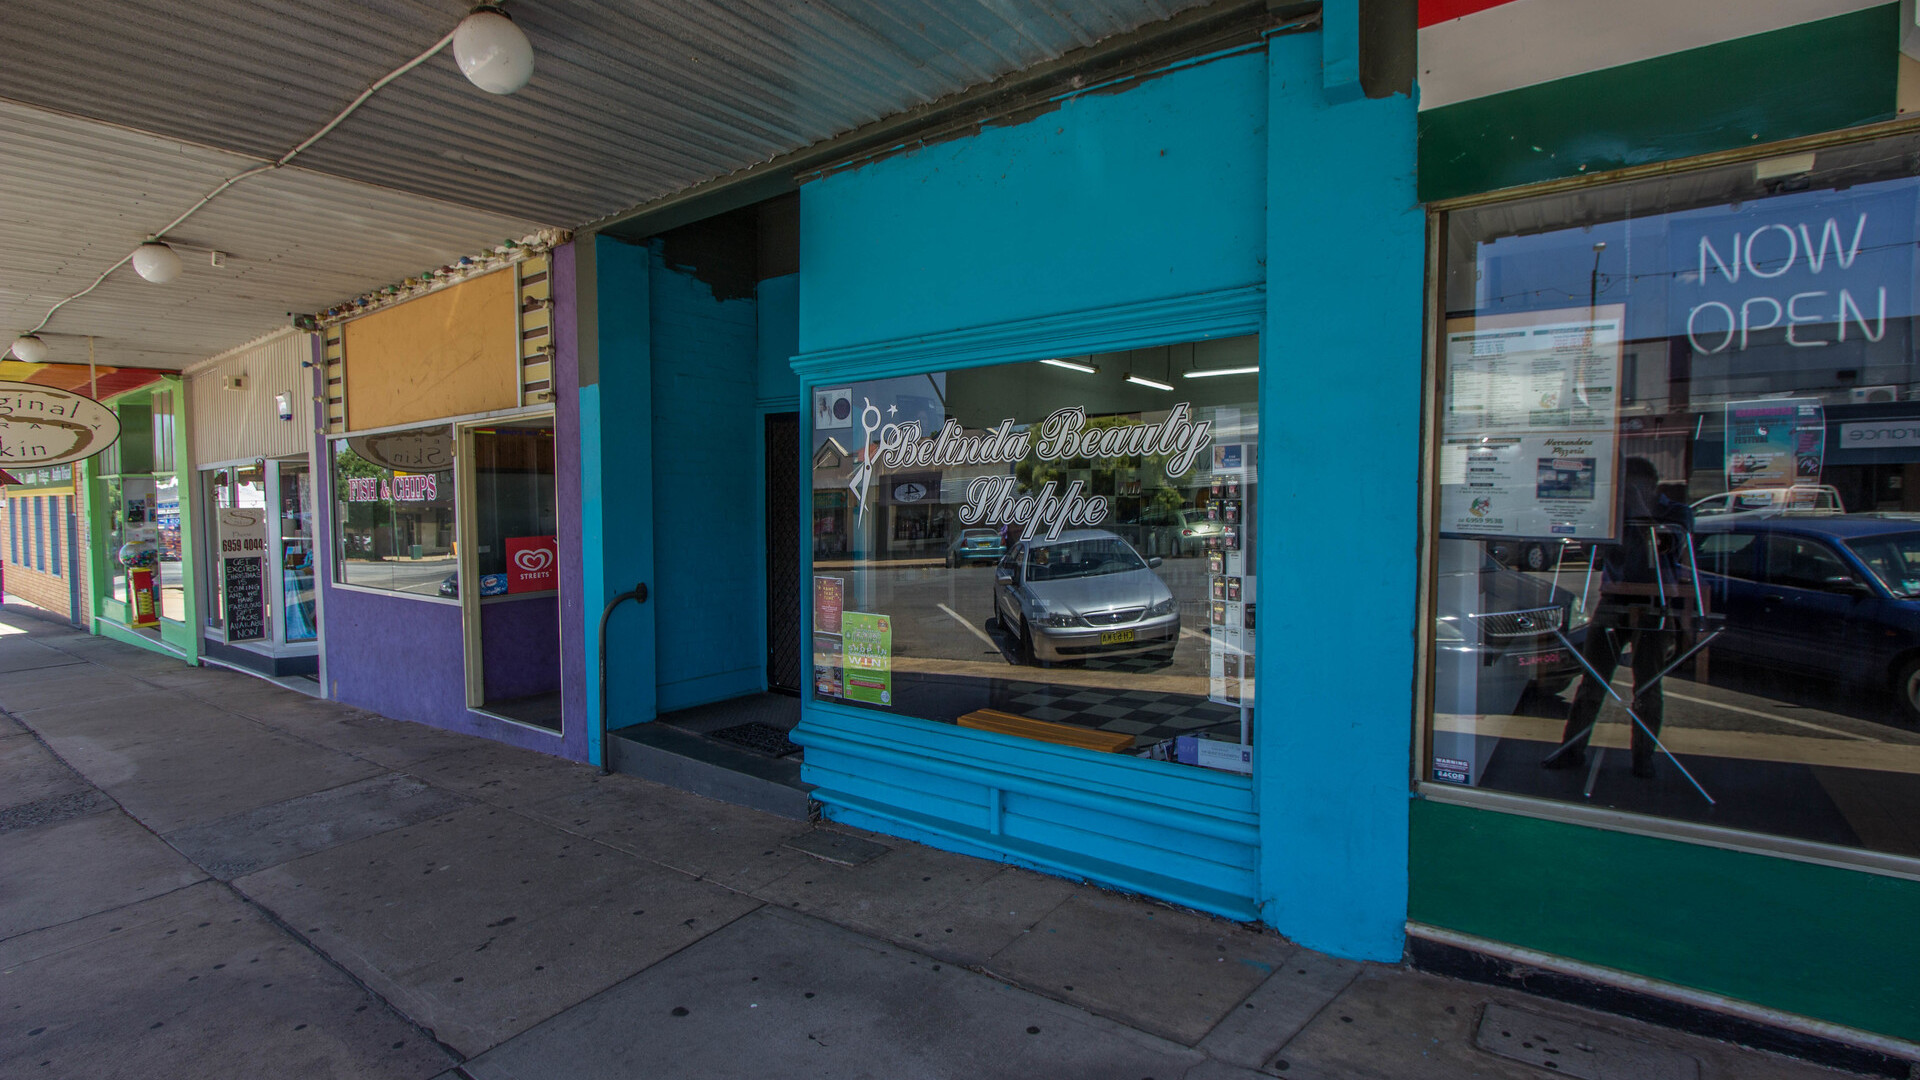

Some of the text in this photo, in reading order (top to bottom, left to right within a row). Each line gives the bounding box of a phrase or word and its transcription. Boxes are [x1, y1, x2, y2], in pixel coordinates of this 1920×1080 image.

[1699, 213, 1867, 286] NOW
[1687, 287, 1887, 356] OPEN
[883, 402, 1212, 478] Belinda Beauty
[348, 473, 438, 502] FISH & CHIPS
[959, 475, 1108, 542] Shoppe
[222, 538, 263, 552] 6959 4044
[232, 558, 251, 566] GET
[520, 571, 550, 580] STREETS
[1435, 757, 1468, 767] WARNING
